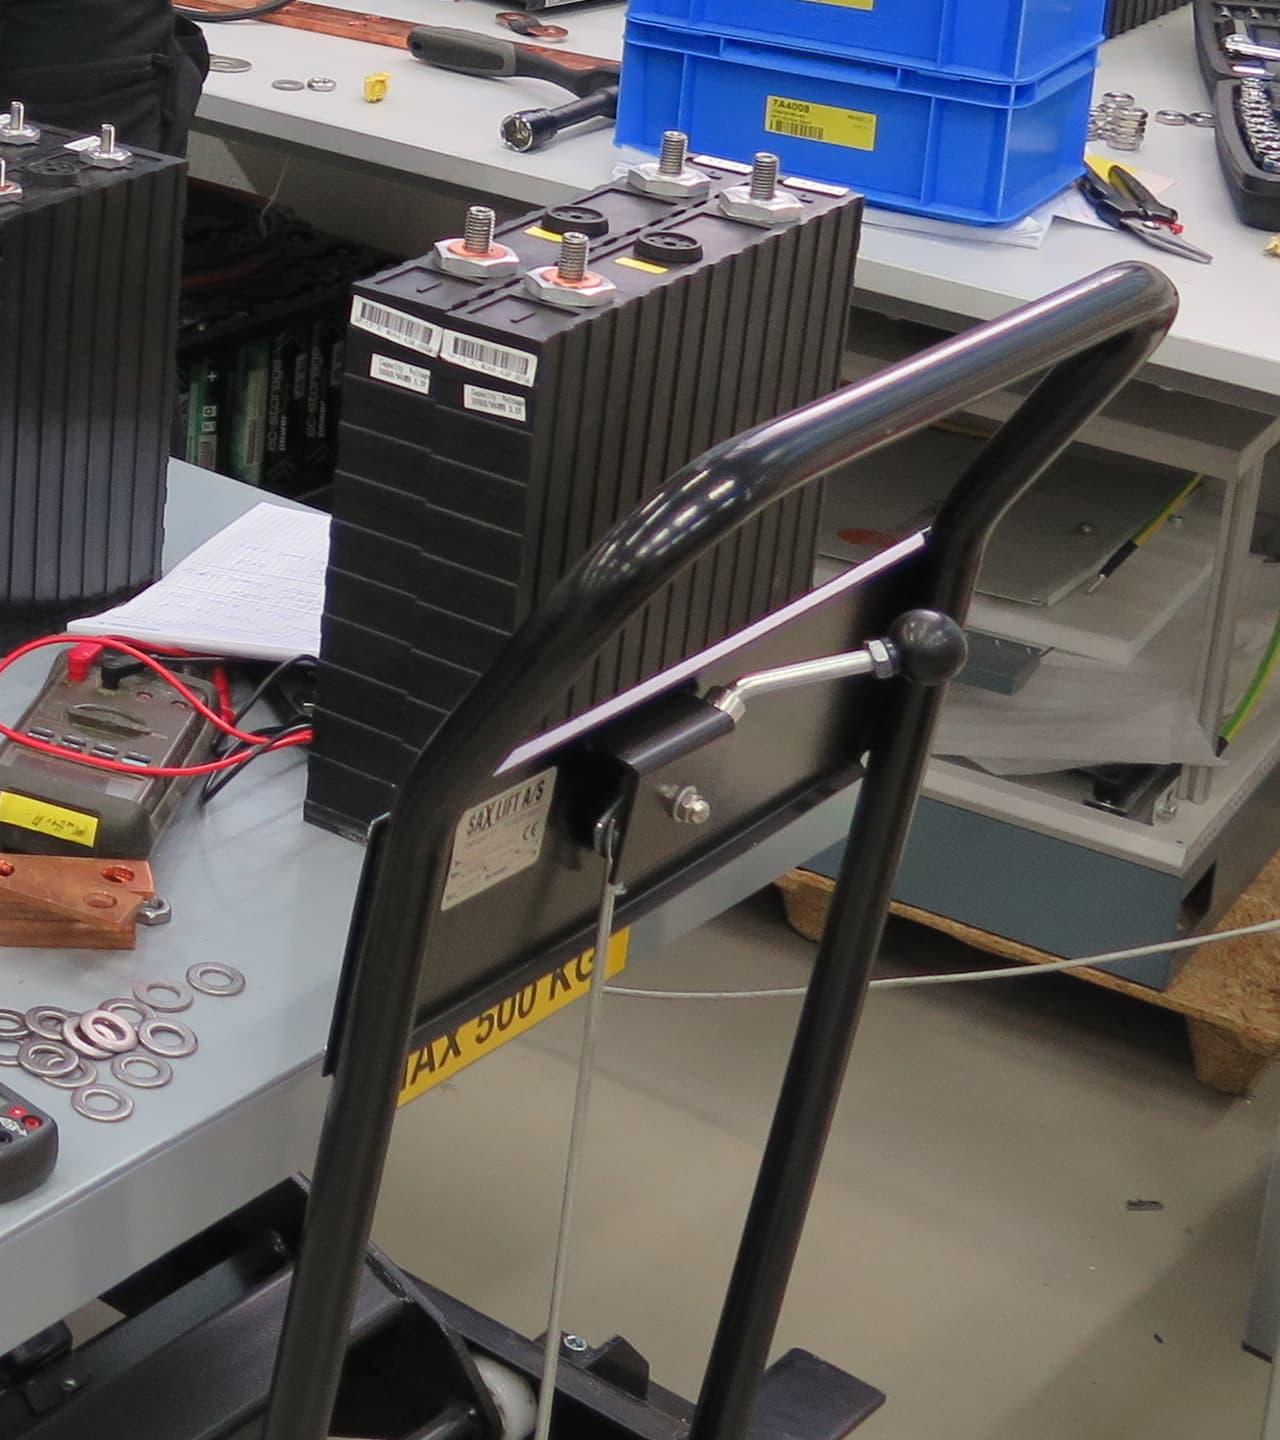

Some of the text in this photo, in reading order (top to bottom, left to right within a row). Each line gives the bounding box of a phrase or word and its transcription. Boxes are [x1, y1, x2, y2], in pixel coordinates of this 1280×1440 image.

[466, 779, 545, 837] SAX LIFT A/S
[400, 1024, 464, 1092] AX
[474, 981, 539, 1045] 500
